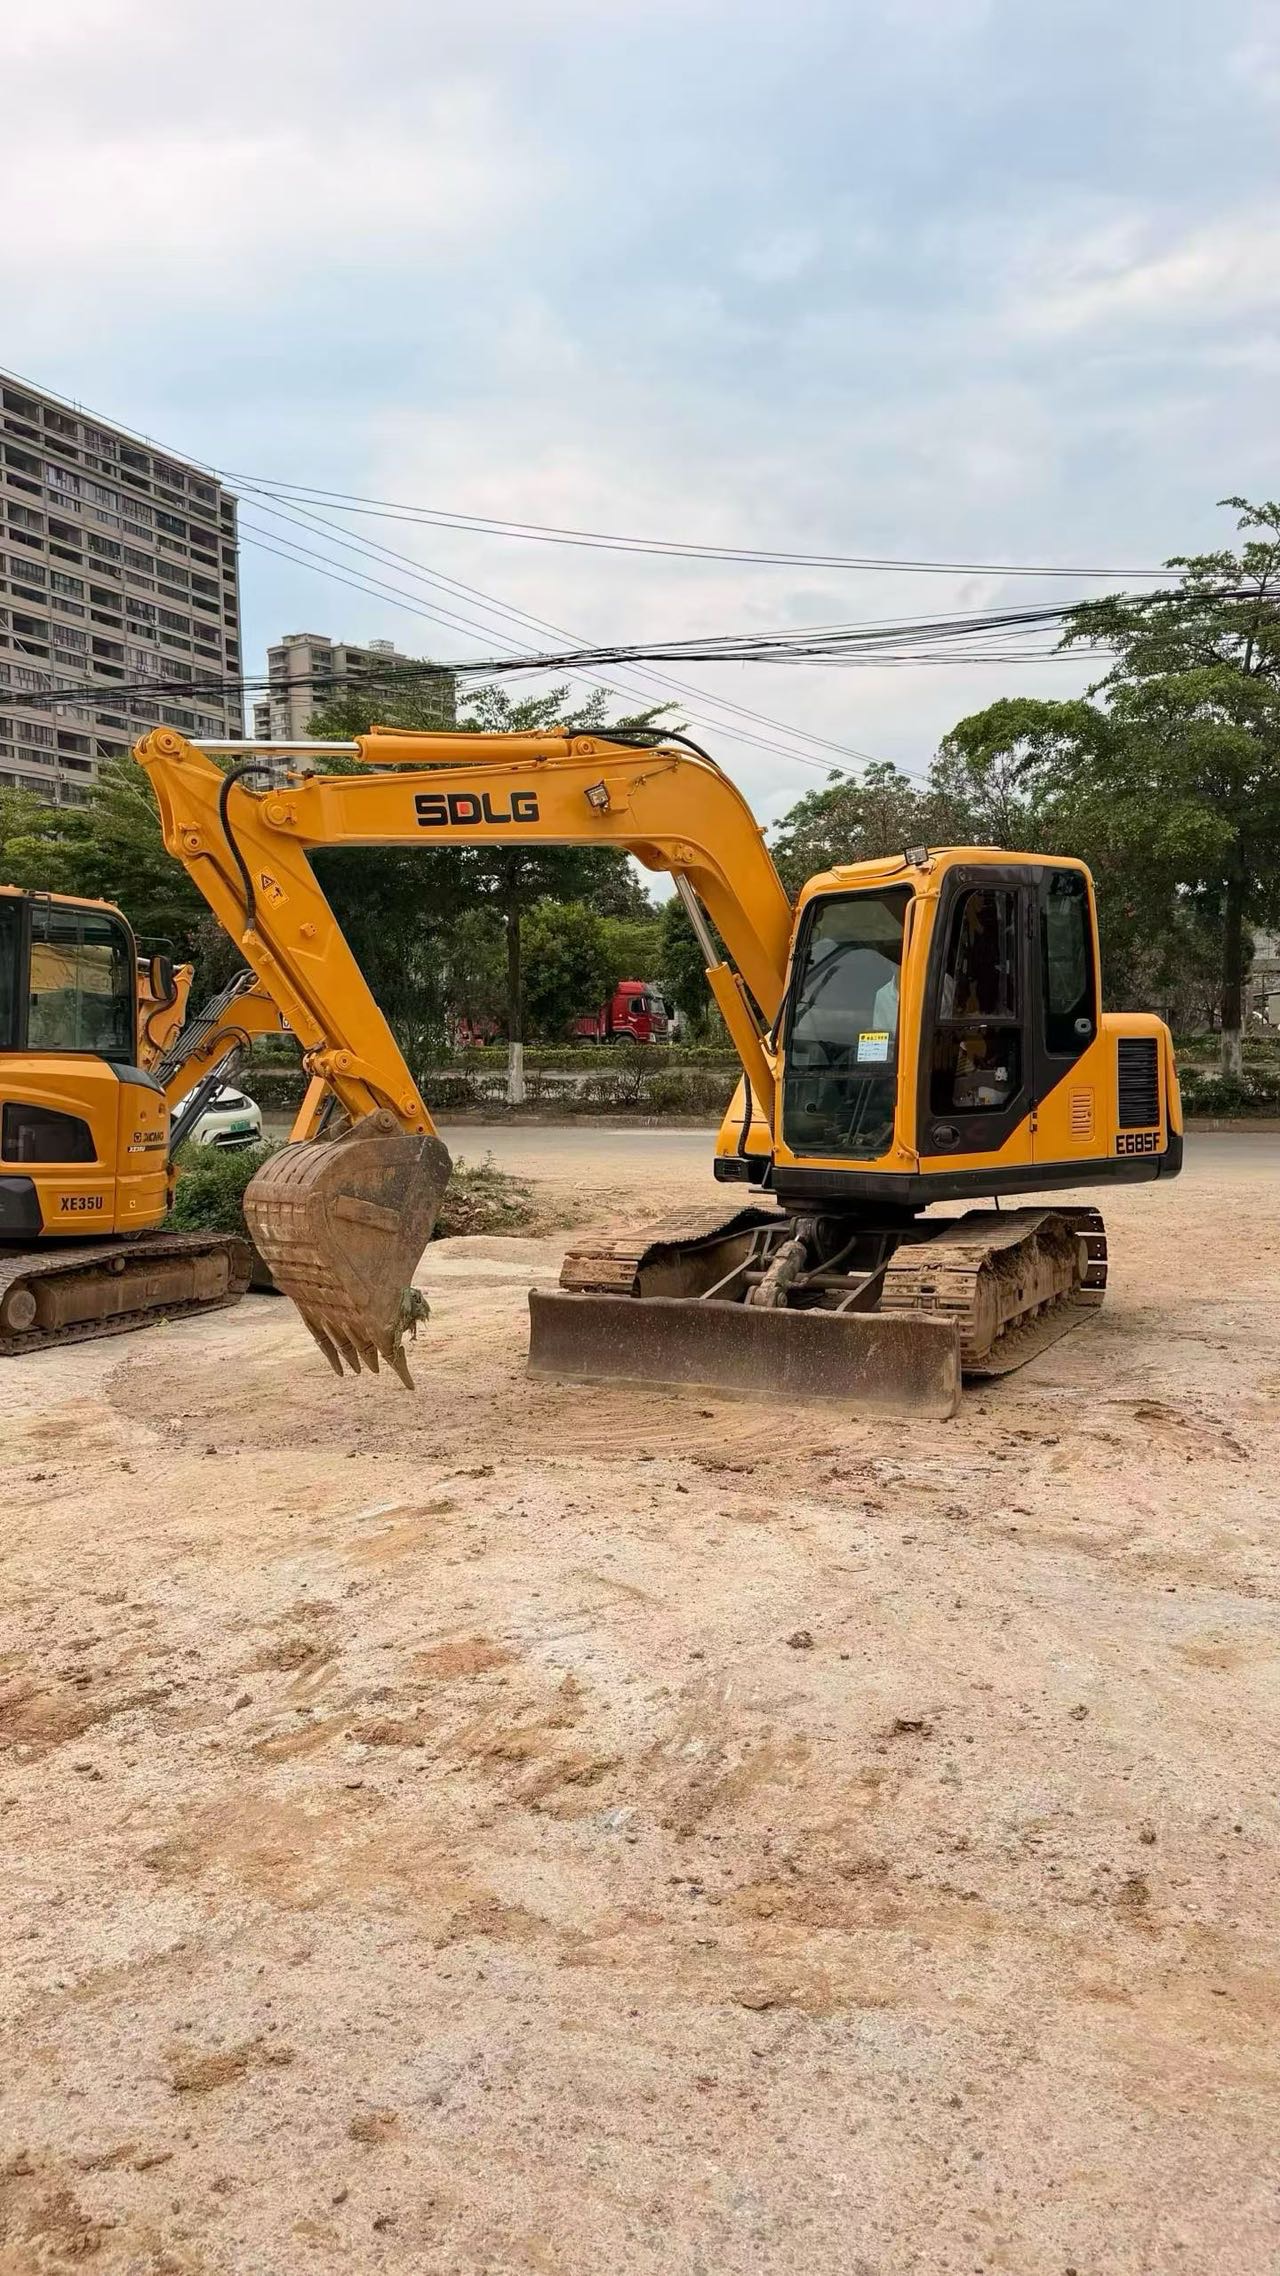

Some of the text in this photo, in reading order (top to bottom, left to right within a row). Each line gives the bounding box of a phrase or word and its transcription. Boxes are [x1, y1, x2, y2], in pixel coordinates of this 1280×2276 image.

[415, 791, 540, 827] SDLG
[1116, 1132, 1161, 1154] E685F
[61, 1196, 103, 1211] XE35U
